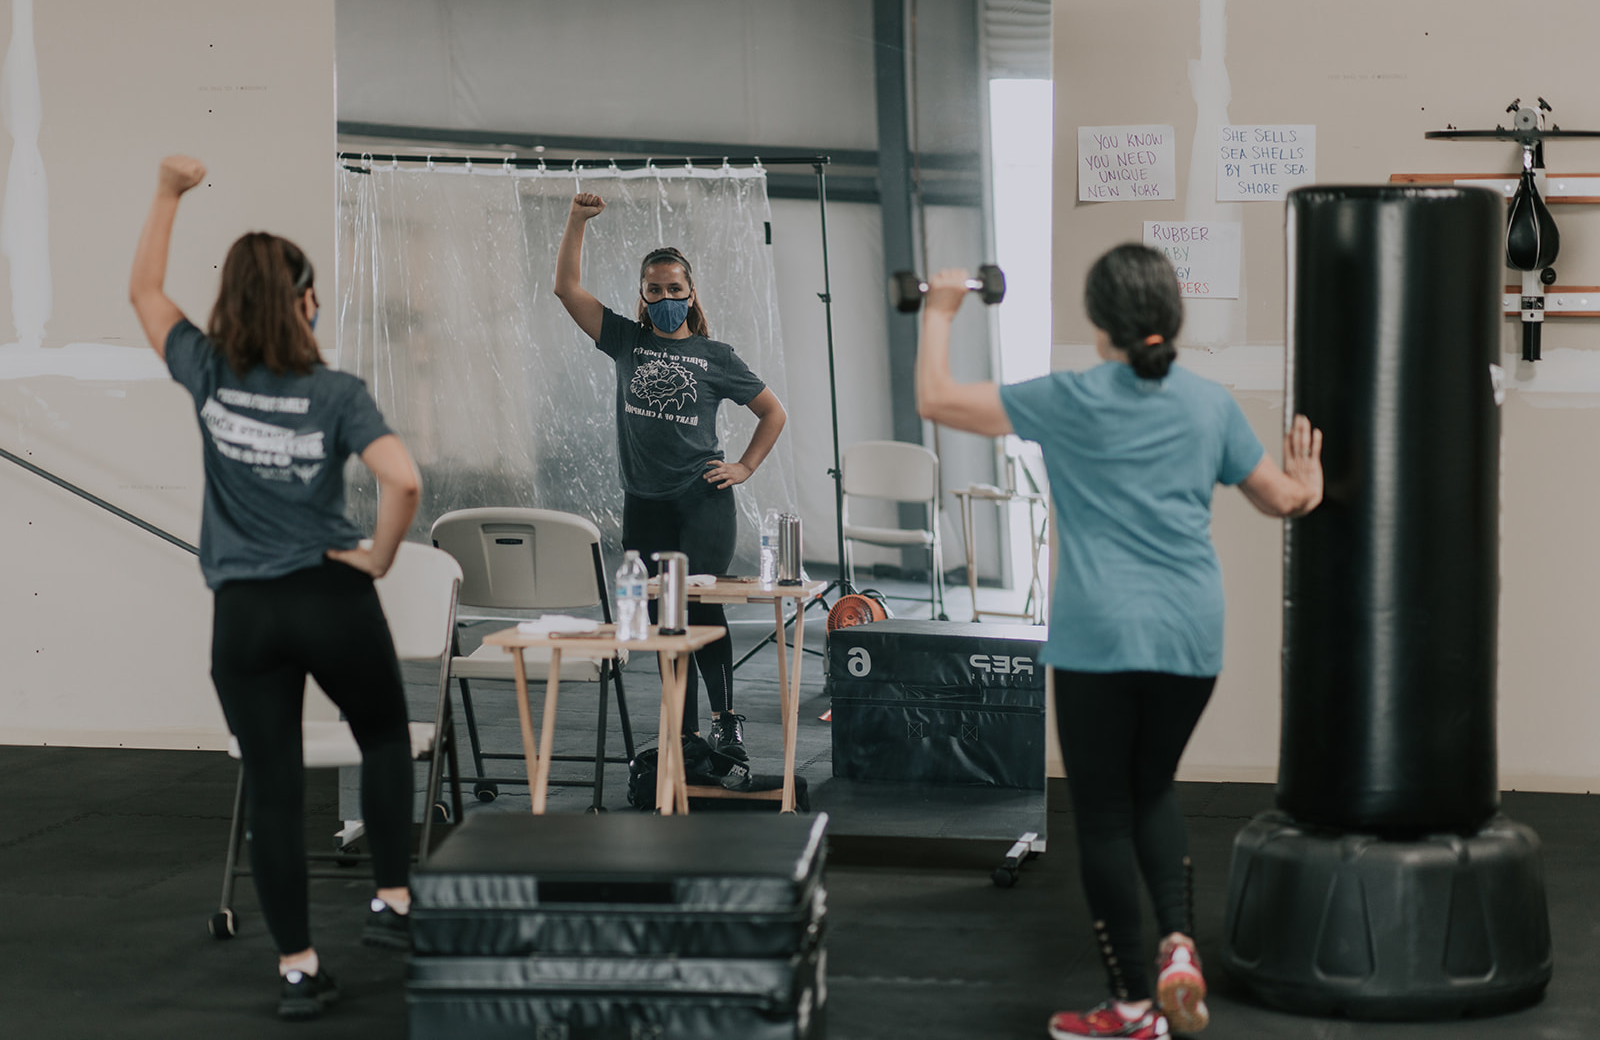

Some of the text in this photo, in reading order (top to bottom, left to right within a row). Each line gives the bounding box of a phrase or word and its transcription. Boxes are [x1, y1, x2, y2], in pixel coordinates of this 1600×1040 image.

[1093, 133, 1163, 150] YOU KNOW
[1222, 127, 1297, 143] SHE SELLS
[1220, 145, 1305, 160] SEA SHELLS
[1085, 151, 1157, 171] YOU NEED
[1099, 168, 1149, 183] UNIQUE
[1224, 163, 1240, 178] BY
[1249, 163, 1278, 175] THE
[1087, 183, 1160, 198] NEW YORK
[1238, 180, 1280, 194] SHORE
[1151, 223, 1209, 243] RUBBER
[1156, 246, 1190, 261] ABY
